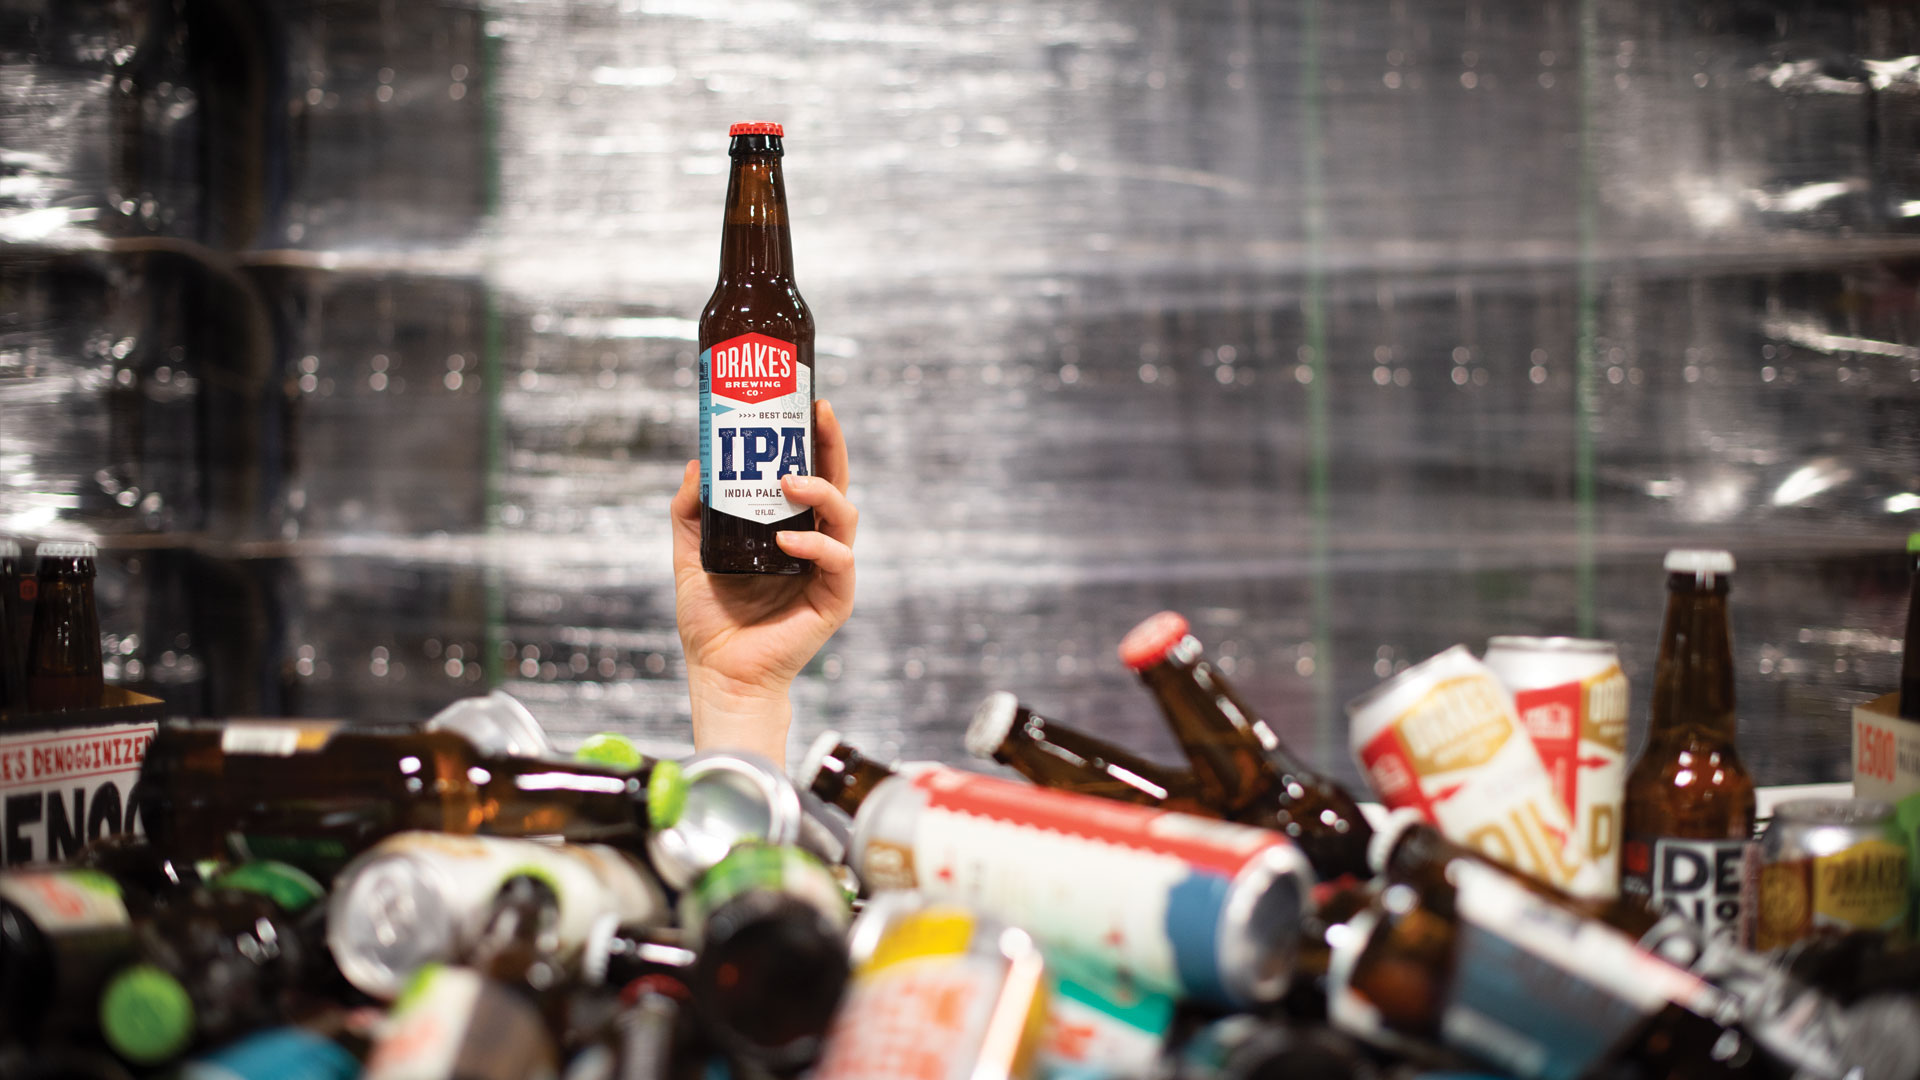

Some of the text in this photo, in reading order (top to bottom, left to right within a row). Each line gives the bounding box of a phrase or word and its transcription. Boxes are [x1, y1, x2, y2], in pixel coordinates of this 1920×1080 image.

[717, 342, 791, 379] DRAKE'S
[759, 412, 803, 420] BEST COAST
[718, 427, 809, 480] IPA
[725, 488, 782, 498] INDIA PALE
[0, 751, 26, 781] E'S
[1858, 722, 1896, 783] 1500
